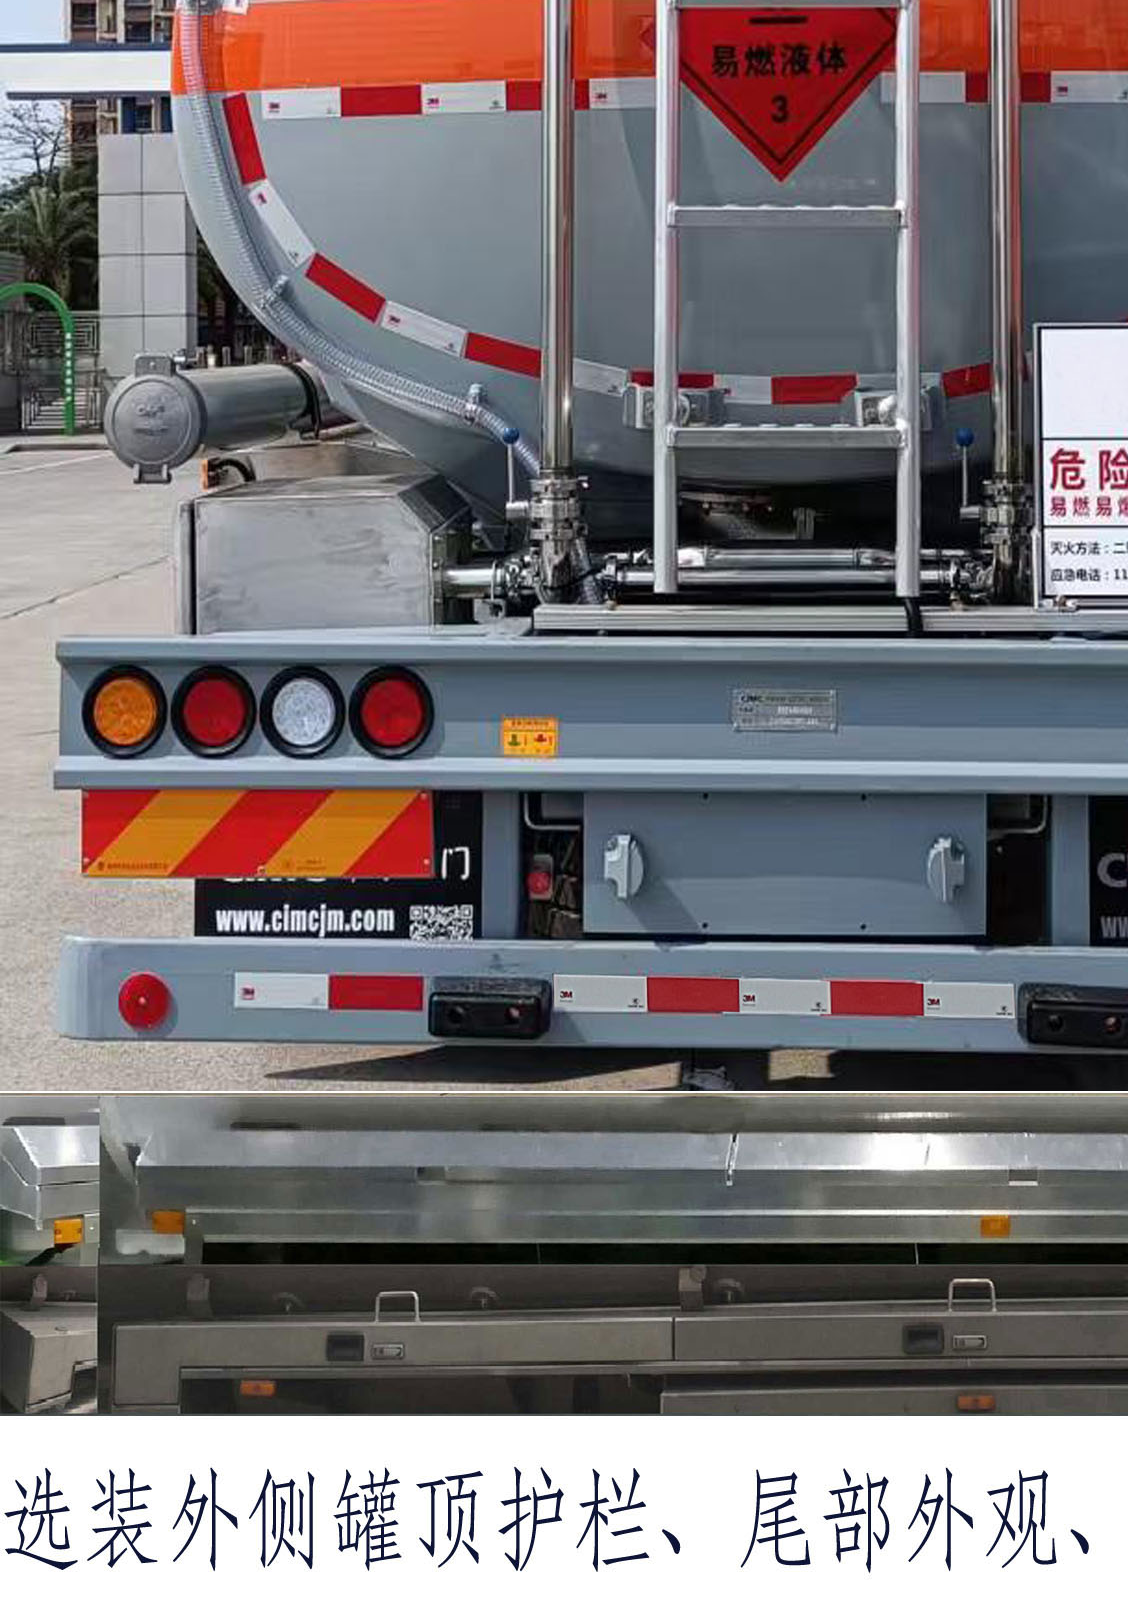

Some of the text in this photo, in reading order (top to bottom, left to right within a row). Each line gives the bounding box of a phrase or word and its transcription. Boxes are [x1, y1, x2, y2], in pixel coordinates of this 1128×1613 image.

[712, 43, 847, 78] 易燃液体
[771, 95, 789, 123] 3
[215, 904, 396, 938] www.cimcjm.com
